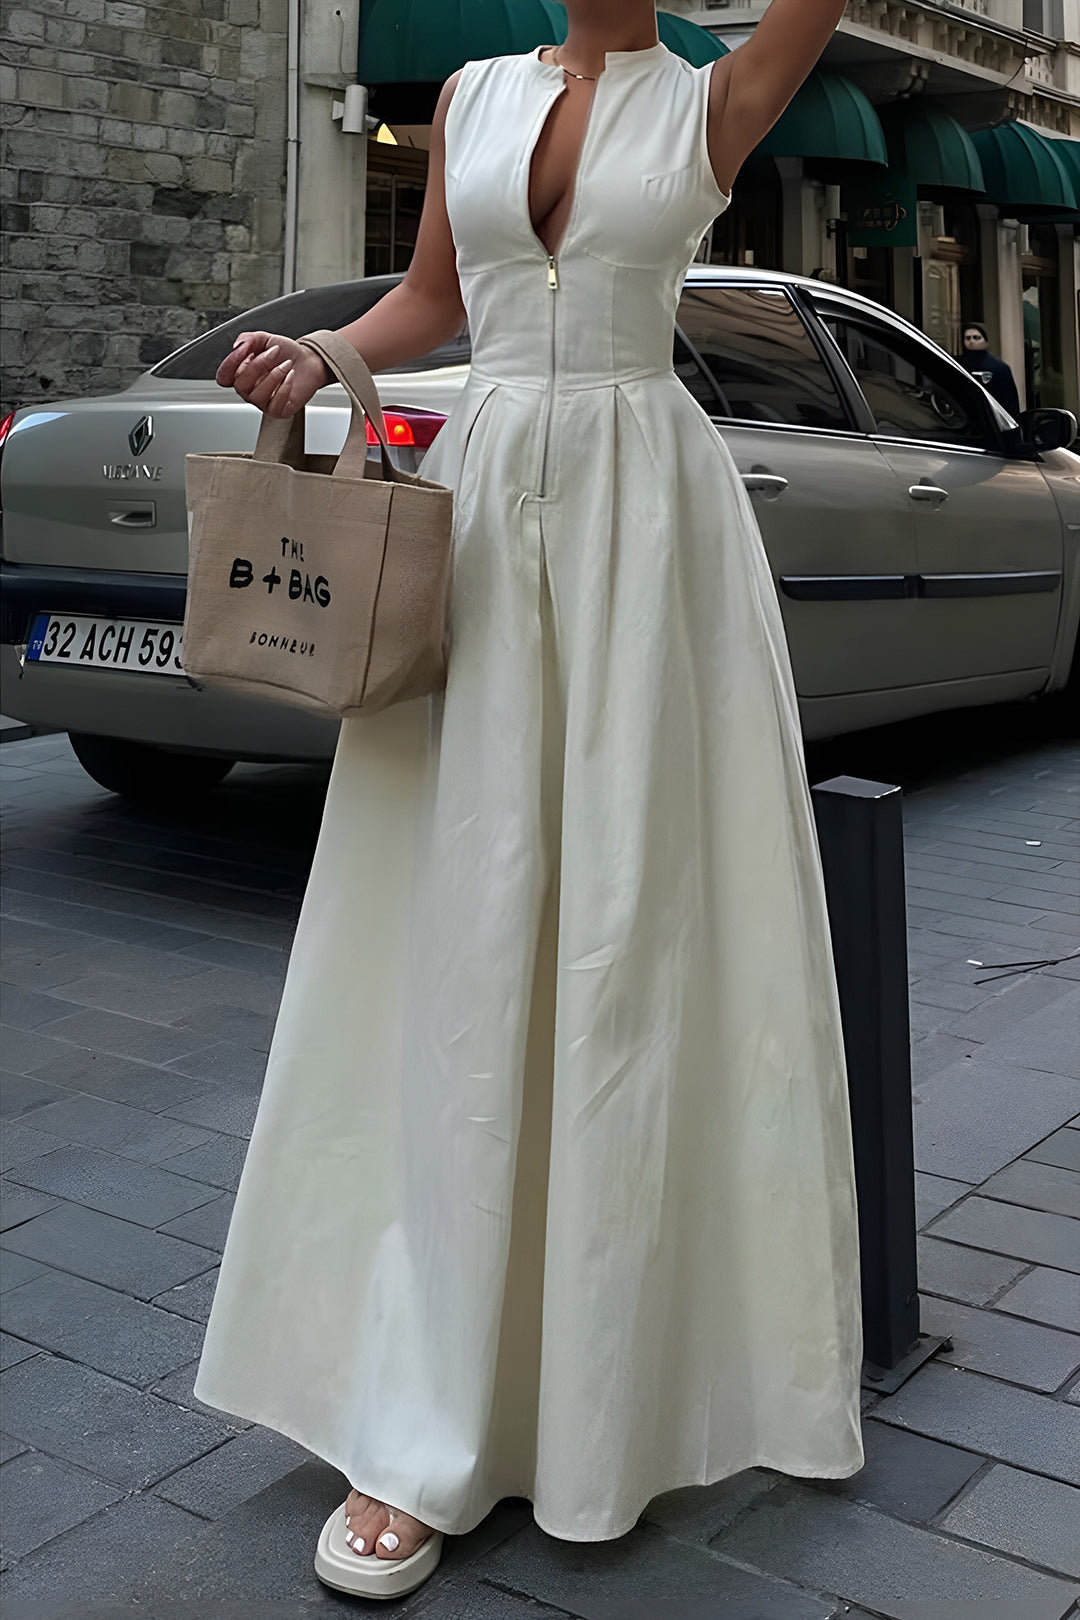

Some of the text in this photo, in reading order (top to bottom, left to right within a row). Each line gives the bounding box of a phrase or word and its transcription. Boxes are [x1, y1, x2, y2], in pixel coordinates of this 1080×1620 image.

[281, 536, 305, 562] THE
[288, 568, 331, 608] BAG
[43, 621, 76, 657] 32
[79, 623, 135, 662] ACH
[249, 631, 315, 657] BONHEUR
